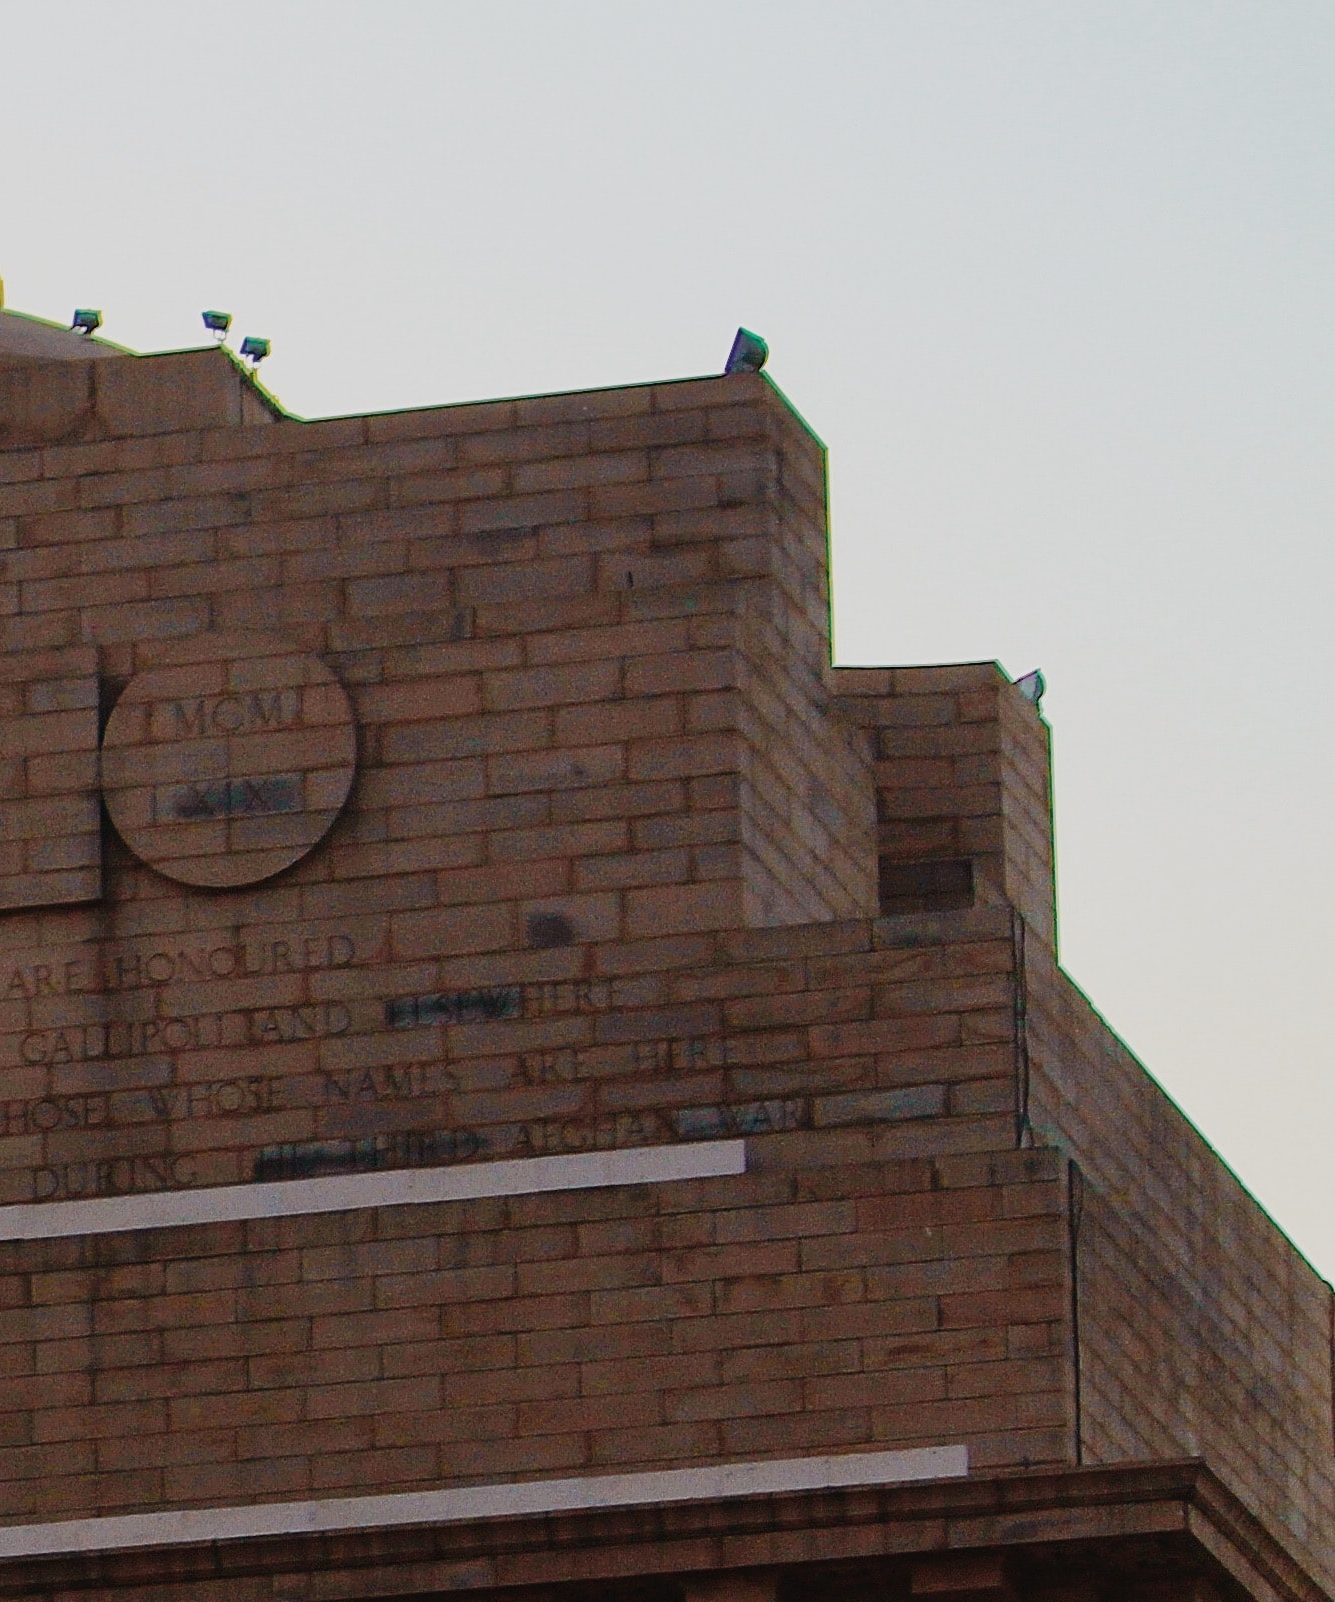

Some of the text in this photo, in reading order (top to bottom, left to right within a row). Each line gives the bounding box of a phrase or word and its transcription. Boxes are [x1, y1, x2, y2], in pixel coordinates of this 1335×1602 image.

[8, 960, 81, 997] ARE
[114, 934, 355, 983] HONOURED
[20, 1012, 226, 1065] GALLIPOLI
[257, 1003, 351, 1041] AND
[150, 1076, 283, 1118] WHOSE
[324, 1063, 461, 1102] NAMES
[31, 1155, 199, 1199] DURING
